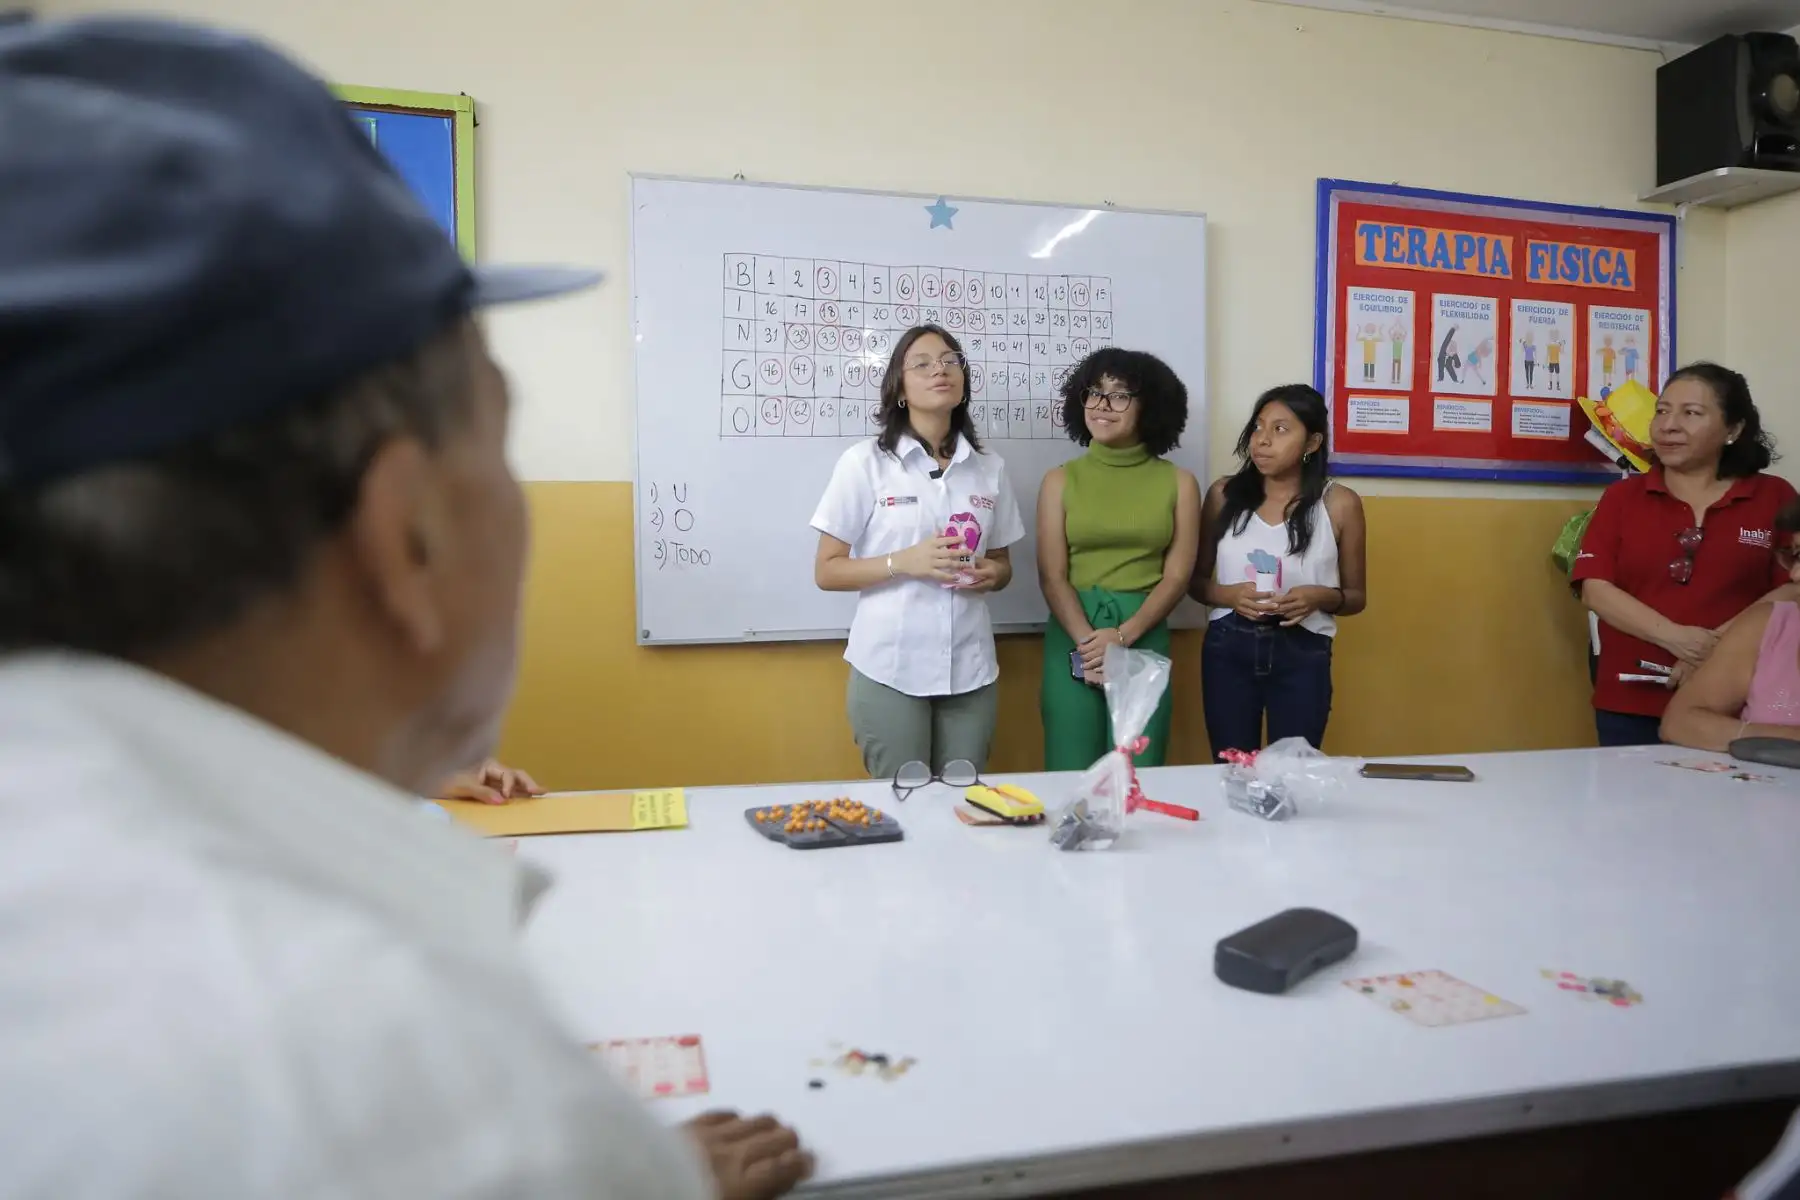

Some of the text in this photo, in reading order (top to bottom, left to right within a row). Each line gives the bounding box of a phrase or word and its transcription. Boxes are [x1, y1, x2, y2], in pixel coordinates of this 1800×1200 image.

[1358, 223, 1633, 288] TERAPIA FISICA
[737, 262, 750, 286] B
[768, 270, 775, 284] 1
[794, 270, 803, 287] 2
[822, 271, 830, 288] 3
[849, 274, 857, 289] 4
[873, 277, 881, 294] 5
[901, 276, 910, 294] 6
[926, 280, 934, 292] 7
[991, 286, 1002, 298] 10
[1035, 287, 1045, 299] 12
[1054, 287, 1064, 300] 13
[1074, 288, 1086, 301] 14
[1096, 288, 1106, 300] 15
[1353, 293, 1408, 304] EJERCICIOS DE
[1360, 304, 1403, 313] EQUILIBRIO
[1439, 300, 1491, 311] EJERCICIOS DE
[1517, 305, 1569, 316] EJERCICIOS DE
[765, 302, 777, 314] 16
[794, 303, 806, 316] 17
[822, 305, 835, 317] 18
[873, 308, 889, 320] 20
[902, 310, 914, 320] 21
[926, 309, 940, 322] 22
[949, 313, 961, 324] 23
[970, 314, 982, 325] 24
[991, 314, 1004, 325] 25
[1013, 315, 1026, 325] 26
[1035, 314, 1045, 323] 27
[1053, 316, 1065, 326] 28
[1074, 317, 1087, 328] 29
[1095, 317, 1108, 329] 30
[1441, 310, 1490, 321] FLEXIBILIDAD
[1594, 312, 1645, 322] EJERCICIOS DE
[738, 320, 749, 341] N
[765, 328, 777, 342] 31
[821, 331, 836, 345] 33
[847, 334, 861, 345] 34
[872, 336, 886, 348] 35
[972, 340, 981, 351] 39
[992, 341, 1005, 351] 40
[1013, 341, 1023, 351] 41
[1034, 343, 1047, 355] 42
[1056, 344, 1067, 355] 43
[1075, 343, 1087, 353] 44
[732, 359, 751, 389] G
[764, 365, 778, 376] 46
[794, 364, 807, 375] 47
[823, 366, 833, 377] 48
[849, 365, 860, 380] 49
[872, 366, 885, 377] 50
[971, 367, 981, 381] 54
[992, 372, 1007, 385] 55
[1014, 372, 1027, 387] 56
[1036, 373, 1046, 385] 57
[733, 407, 749, 433] O
[766, 403, 778, 418] 61
[794, 403, 807, 417] 62
[819, 404, 833, 417] 63
[847, 404, 859, 418] 64
[973, 407, 984, 421] 69
[992, 407, 1005, 421] 70
[1014, 407, 1025, 421] 71
[1036, 407, 1048, 420] 72
[674, 483, 686, 503] U
[651, 507, 663, 532] 2)
[654, 539, 711, 570] 3) TODO
